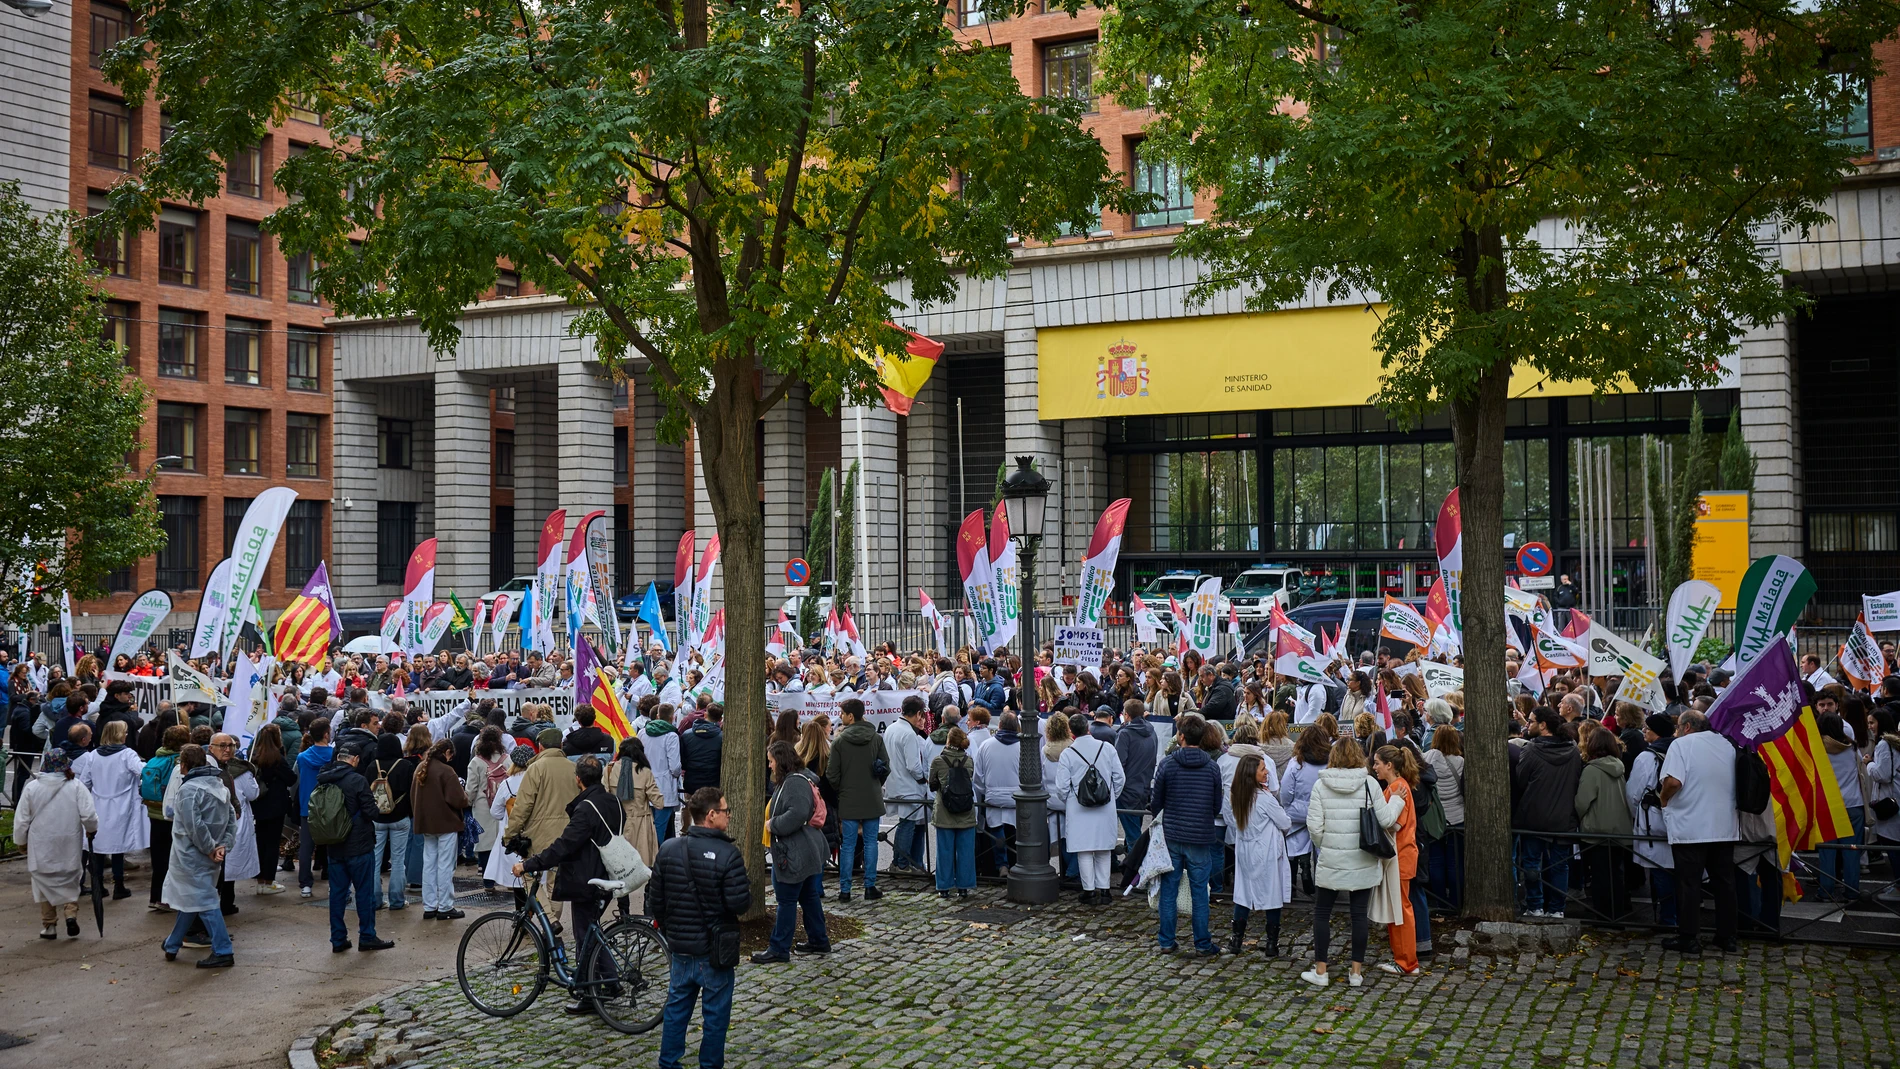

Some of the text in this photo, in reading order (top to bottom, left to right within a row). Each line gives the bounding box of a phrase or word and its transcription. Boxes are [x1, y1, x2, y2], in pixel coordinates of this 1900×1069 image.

[1224, 373, 1268, 383] MINISTERIO
[1224, 383, 1272, 393] DE SANIDAD
[231, 525, 265, 601] Málaga
[141, 596, 169, 609] SMA
[995, 567, 1008, 626] Sindicato Médico
[1078, 565, 1096, 625] Sindicato Médico
[1755, 569, 1786, 623] Málaga
[1388, 604, 1414, 620] SINDICATO
[1870, 602, 1895, 610] Estatuto
[1672, 596, 1712, 649] SMA
[199, 617, 219, 649] SMA
[1058, 629, 1102, 641] SOMOS EL
[1056, 647, 1080, 659] SALUD
[507, 697, 522, 717] LA
[876, 707, 903, 715] MARCO
